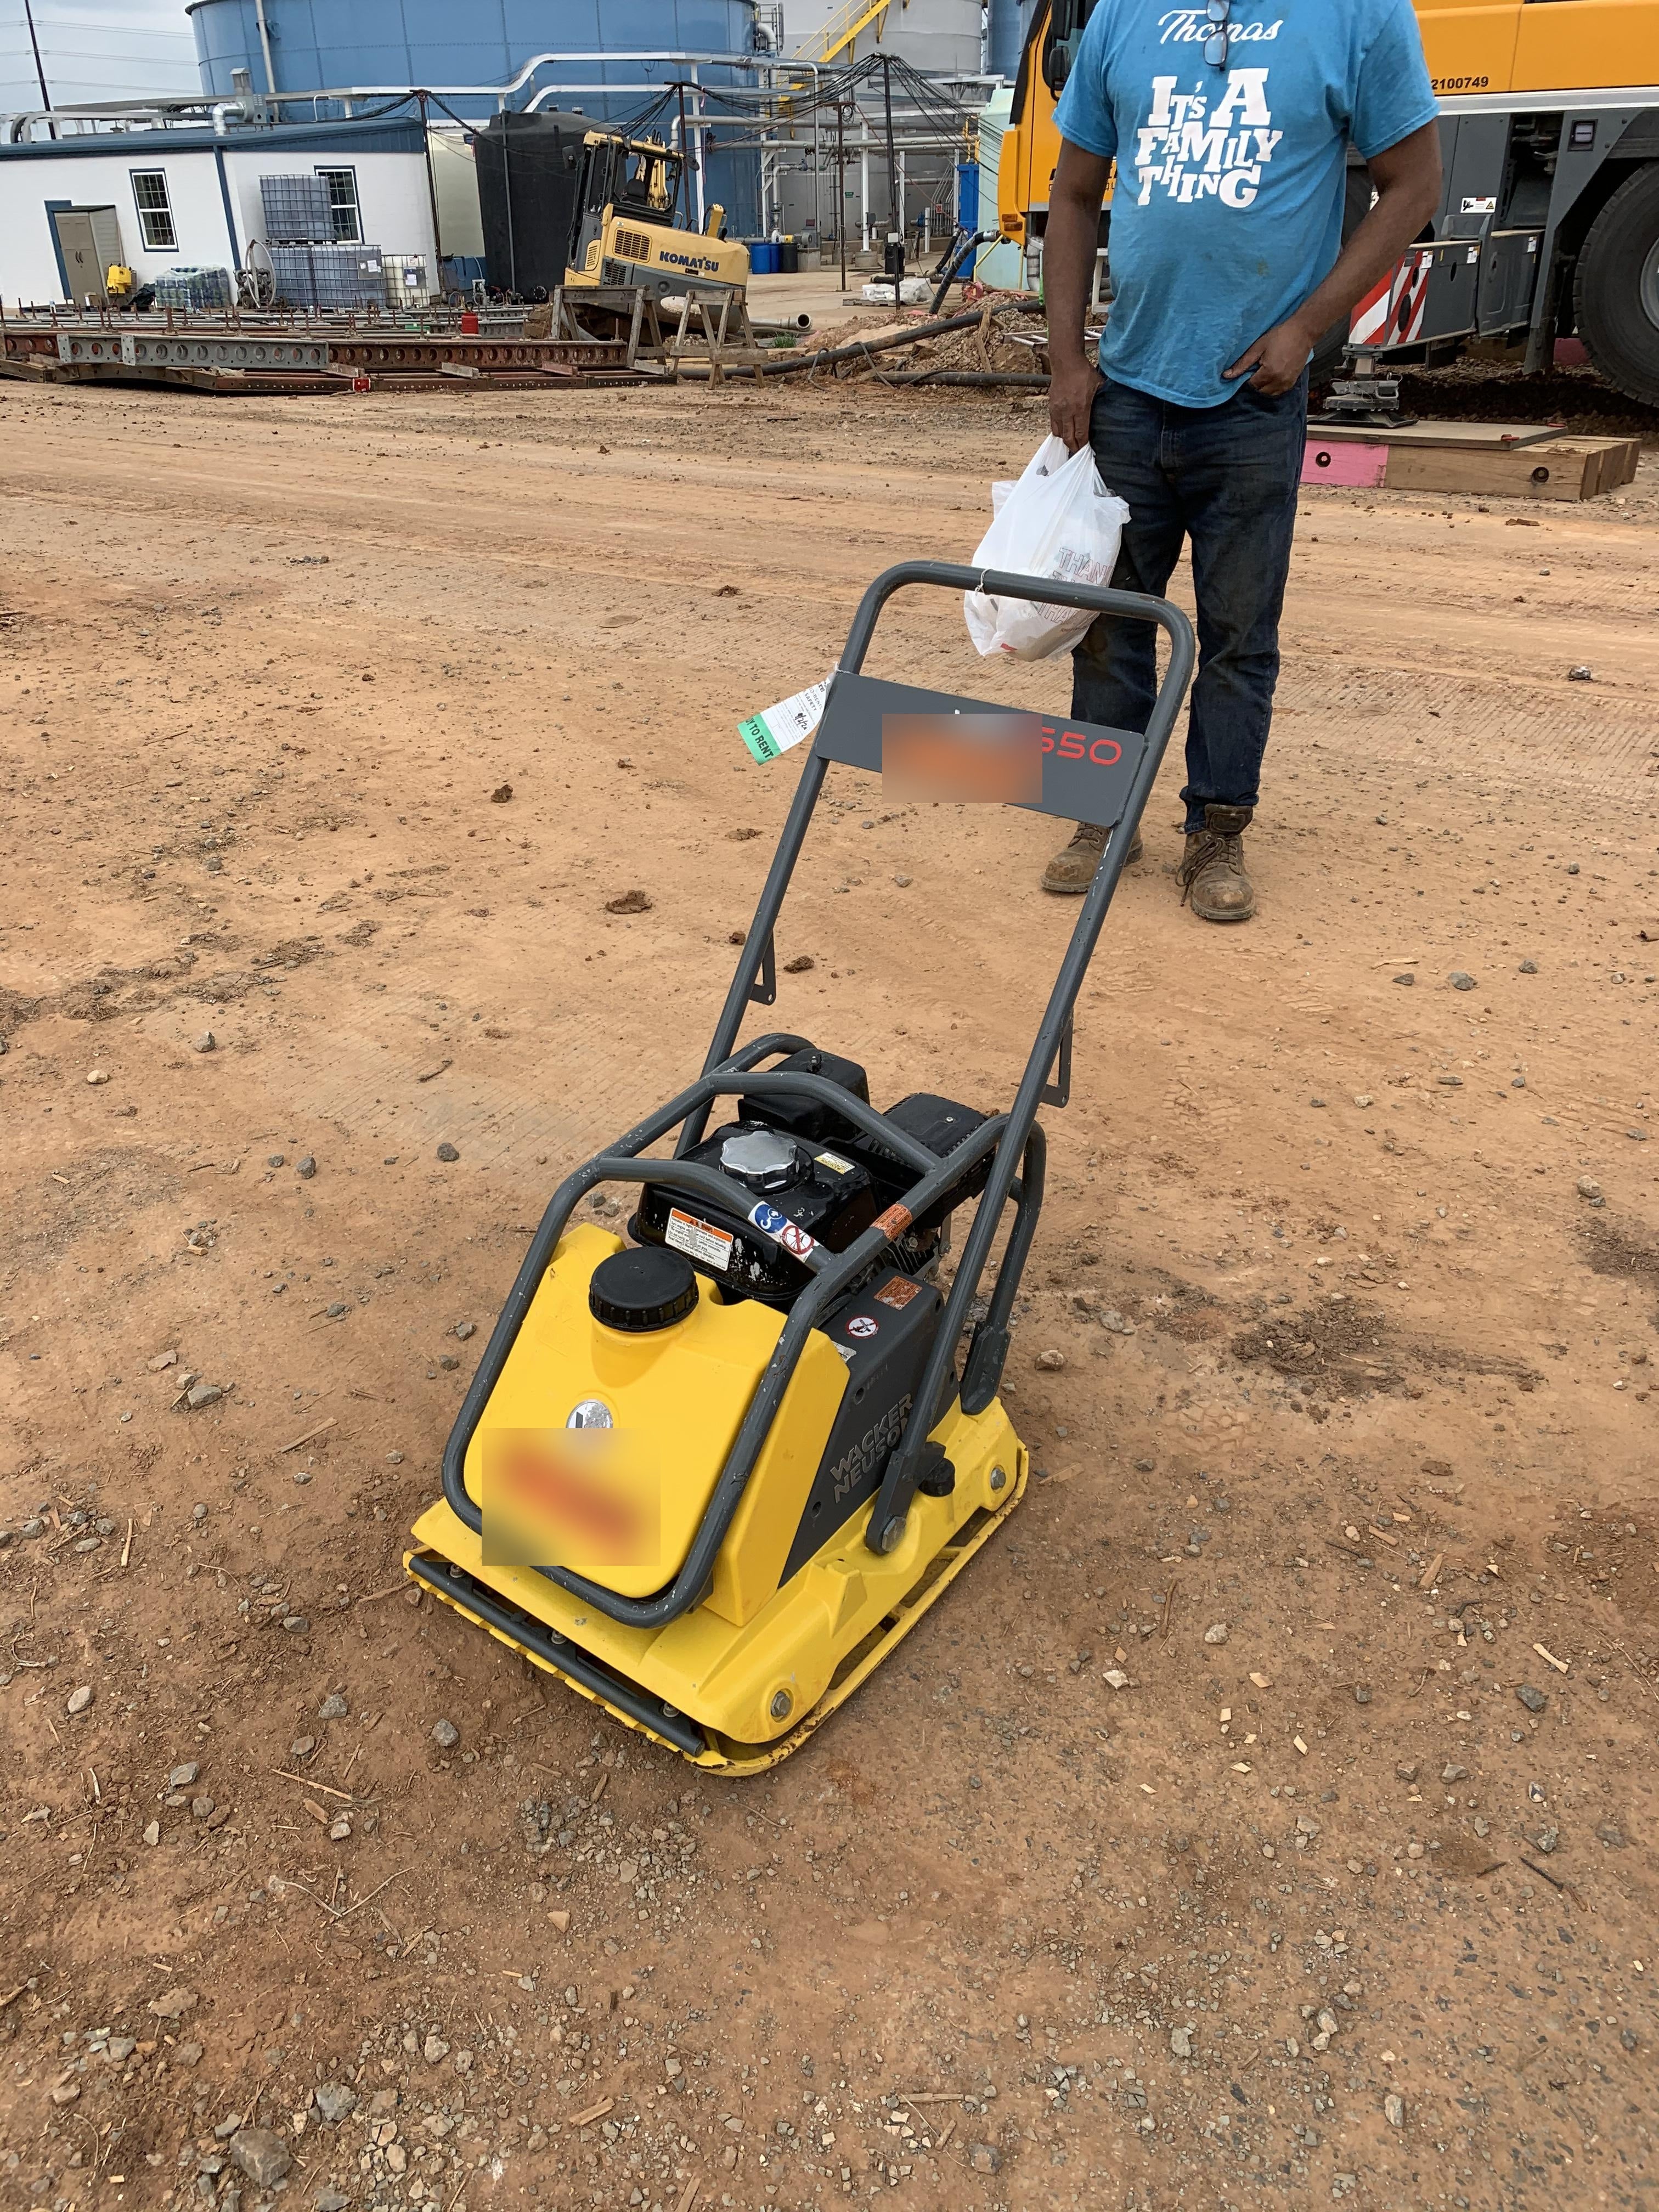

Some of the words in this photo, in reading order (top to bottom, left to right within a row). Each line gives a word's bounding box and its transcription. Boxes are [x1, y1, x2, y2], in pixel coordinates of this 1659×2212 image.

[1158, 9, 1284, 44] Thomas
[1209, 67, 1272, 128] A
[1431, 76, 1489, 90] 2100749
[1135, 121, 1283, 173] FAMILY
[1137, 155, 1262, 208] THING
[659, 251, 719, 272] KOMATSU
[804, 692, 817, 712] SAFETY
[749, 724, 760, 736] TO
[755, 735, 774, 758] RENT
[830, 1393, 913, 1481] WACKER
